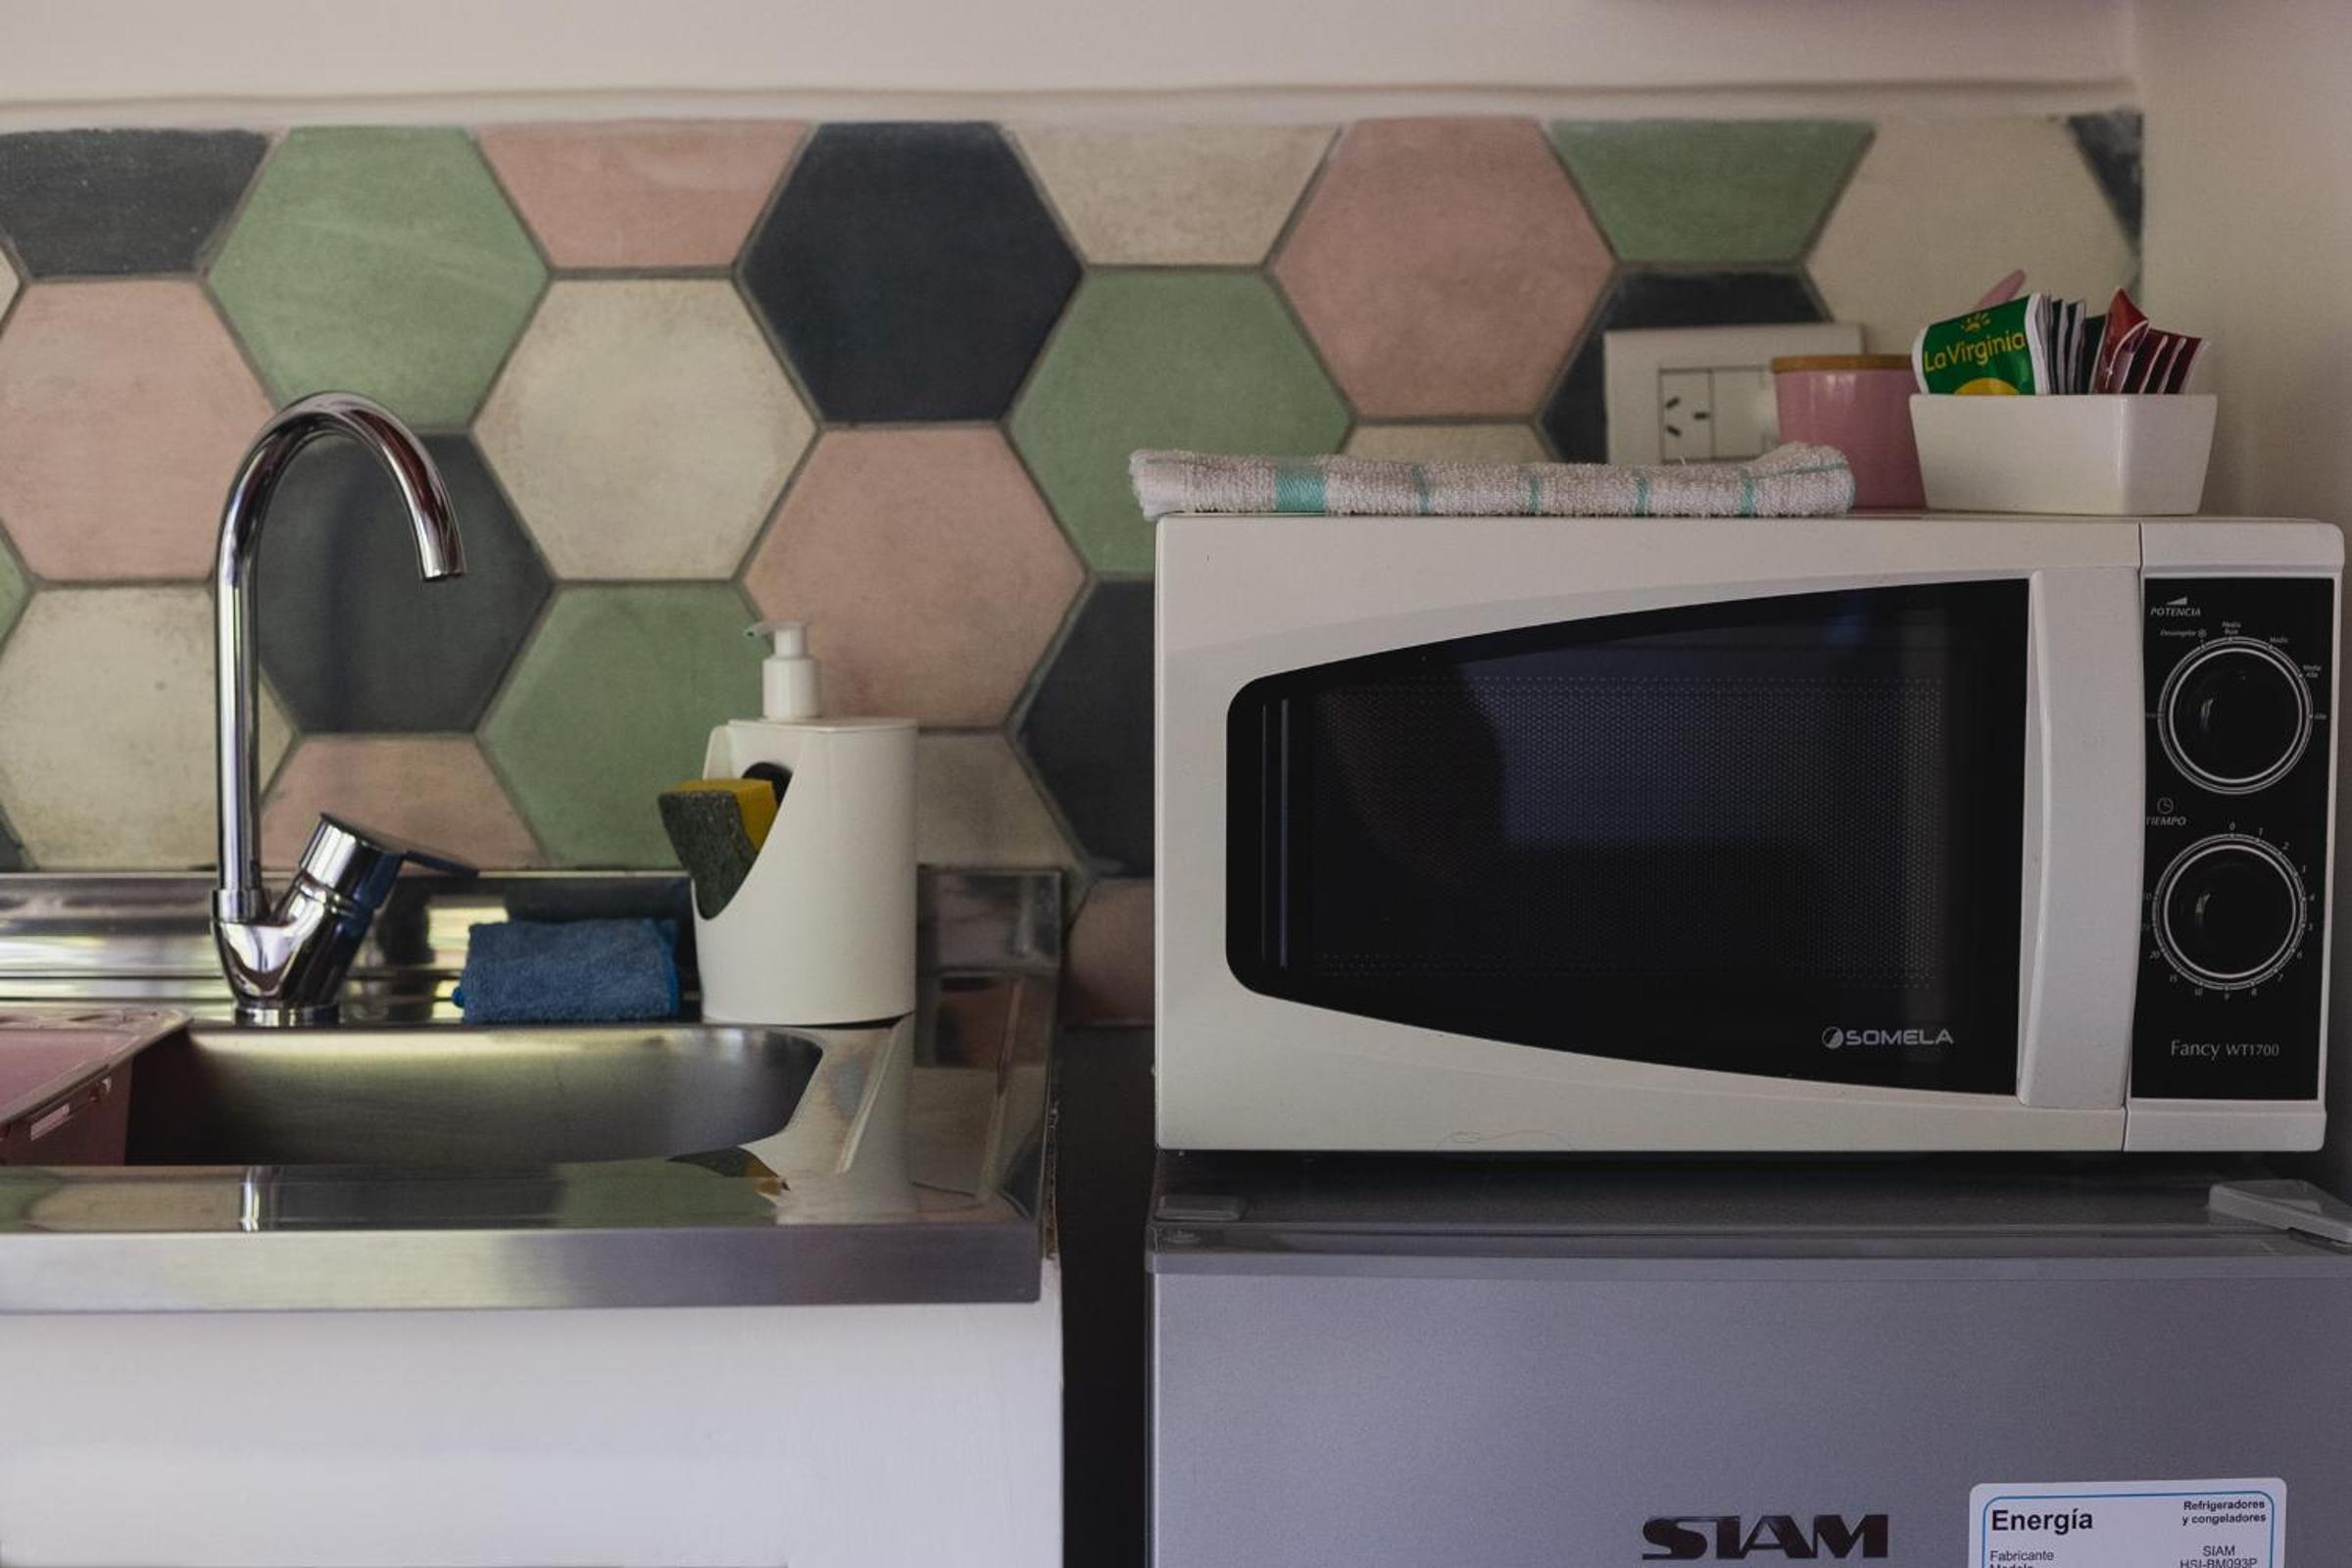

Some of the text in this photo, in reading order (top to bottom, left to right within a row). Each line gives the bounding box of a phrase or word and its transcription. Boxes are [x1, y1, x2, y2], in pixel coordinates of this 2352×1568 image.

[2150, 607, 2202, 617] POTENCIA
[2145, 815, 2186, 826] TIEMPO
[1845, 1029, 1954, 1046] SOMELA
[2171, 1040, 2279, 1060] Fancy WT1700
[2183, 1499, 2265, 1512] Refrigeradores
[1991, 1507, 2093, 1536] Energía
[2181, 1513, 2267, 1526] y congeladores
[1642, 1514, 1888, 1560] SIAM
[1990, 1549, 2054, 1561] Fabricante
[2202, 1545, 2235, 1557] SIAM
